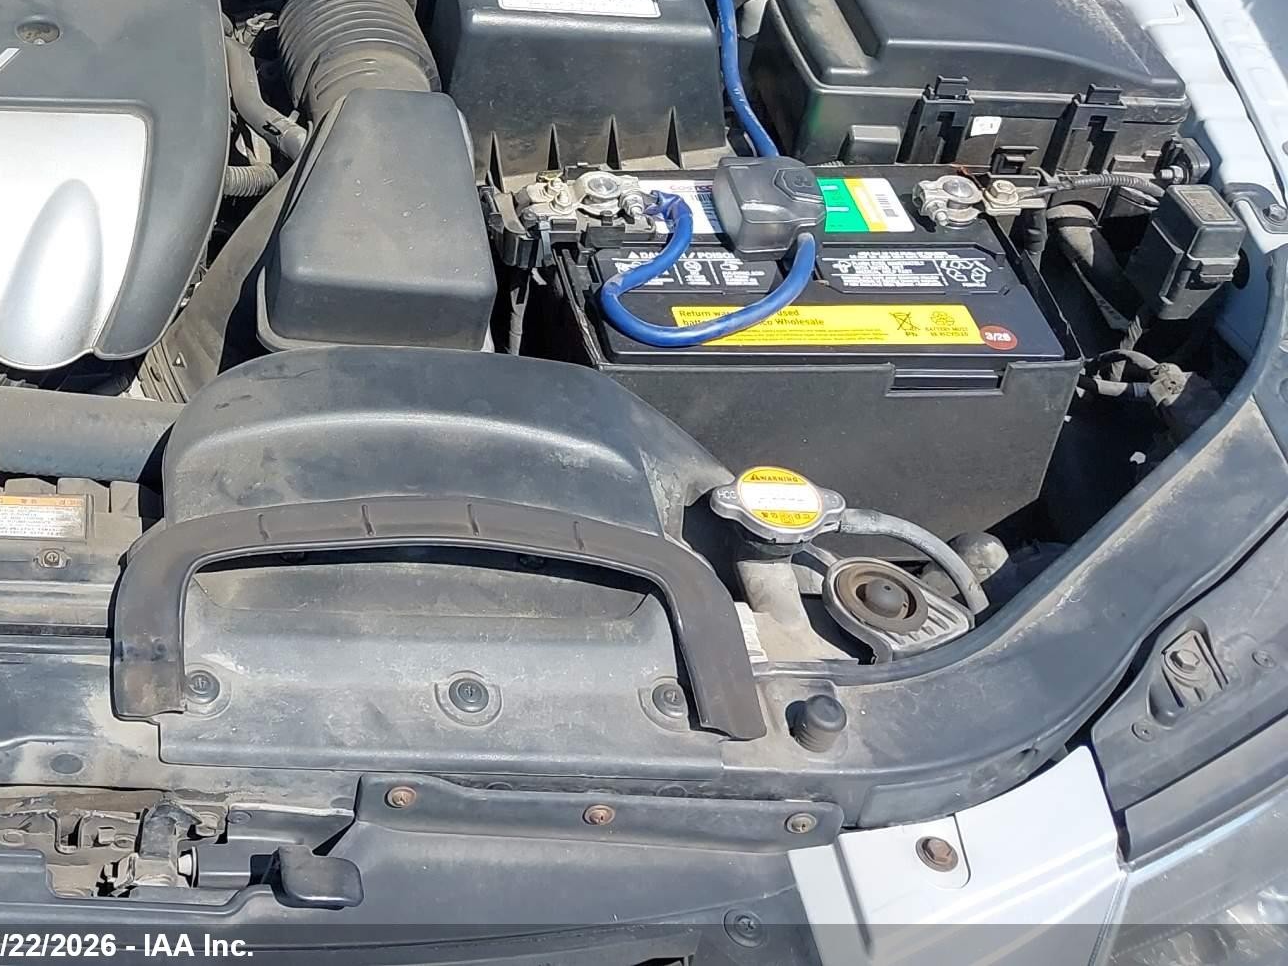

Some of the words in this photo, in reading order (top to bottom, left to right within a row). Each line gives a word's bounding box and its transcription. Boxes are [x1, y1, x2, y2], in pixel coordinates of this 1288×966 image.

[679, 310, 711, 318] Return
[774, 318, 825, 327] Wholesale
[759, 475, 799, 483] WARNING
